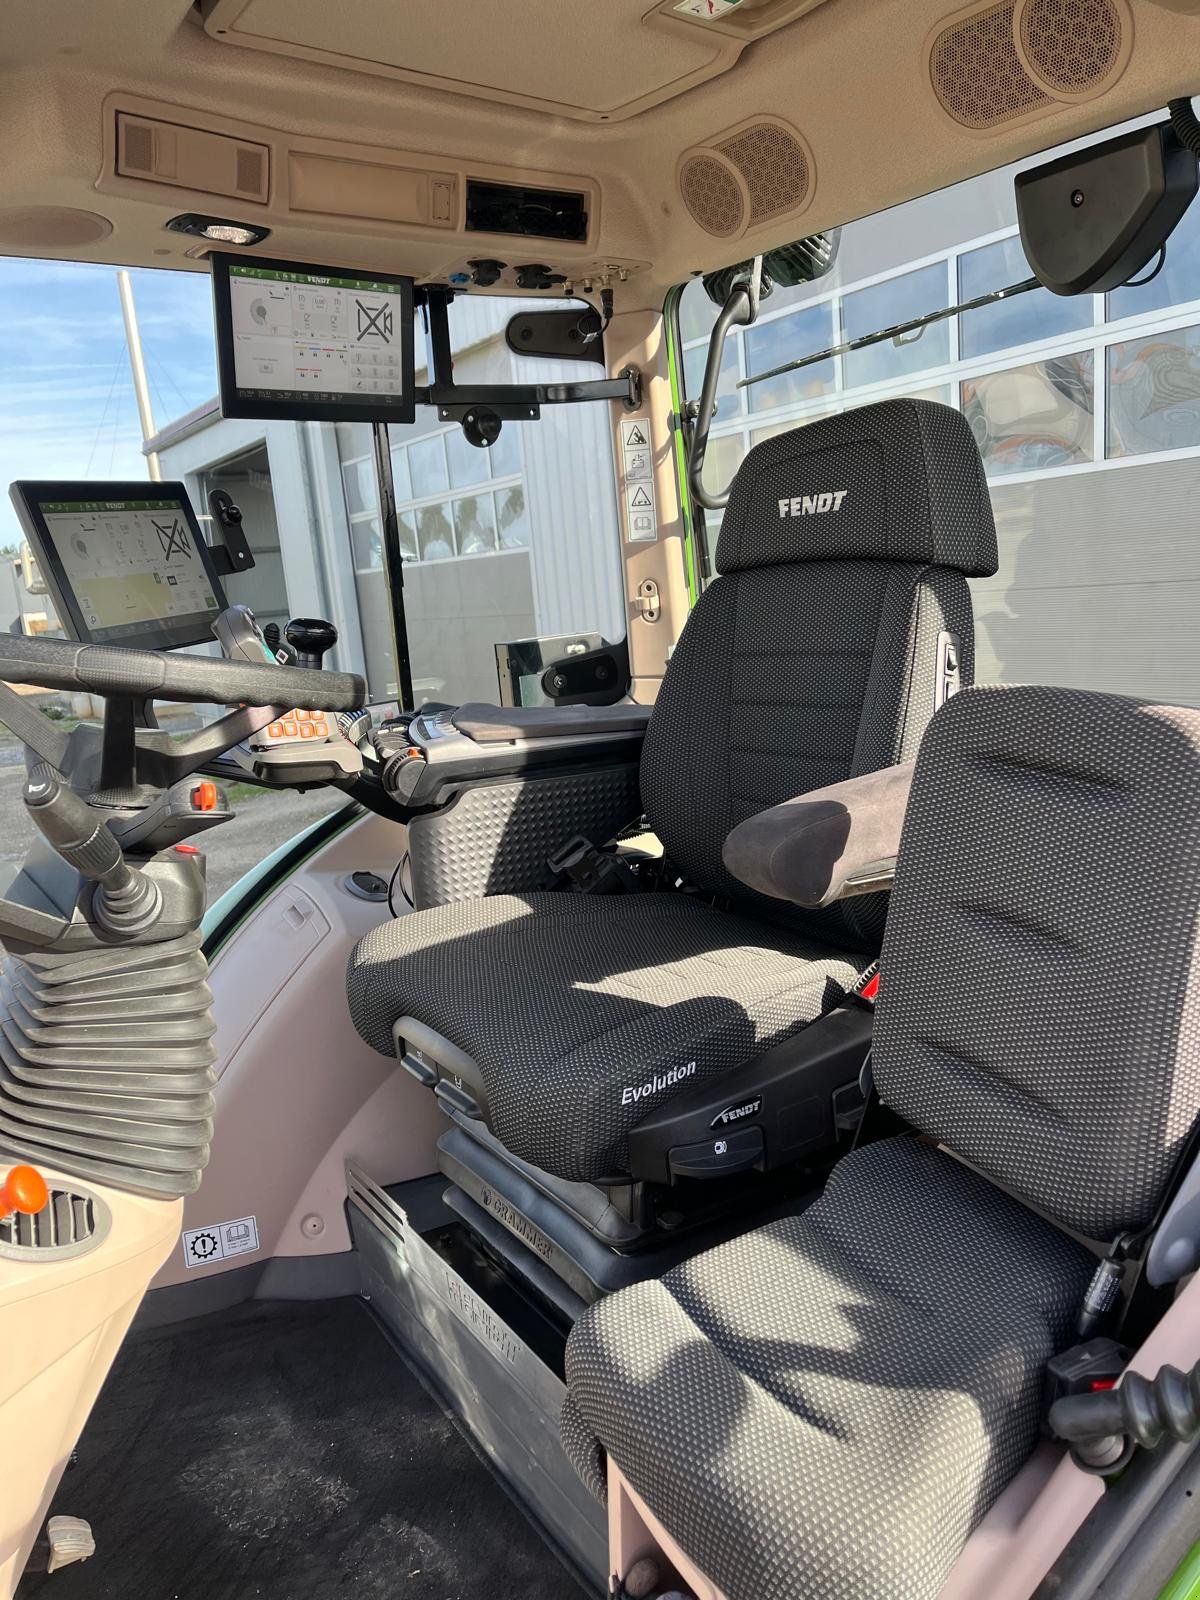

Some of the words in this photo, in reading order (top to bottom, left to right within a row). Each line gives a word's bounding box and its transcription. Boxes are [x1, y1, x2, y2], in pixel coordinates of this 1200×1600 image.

[778, 489, 848, 518] FENDT
[621, 1061, 696, 1106] Evolution
[721, 1100, 761, 1124] FENDT
[493, 1199, 553, 1260] GRAMMER
